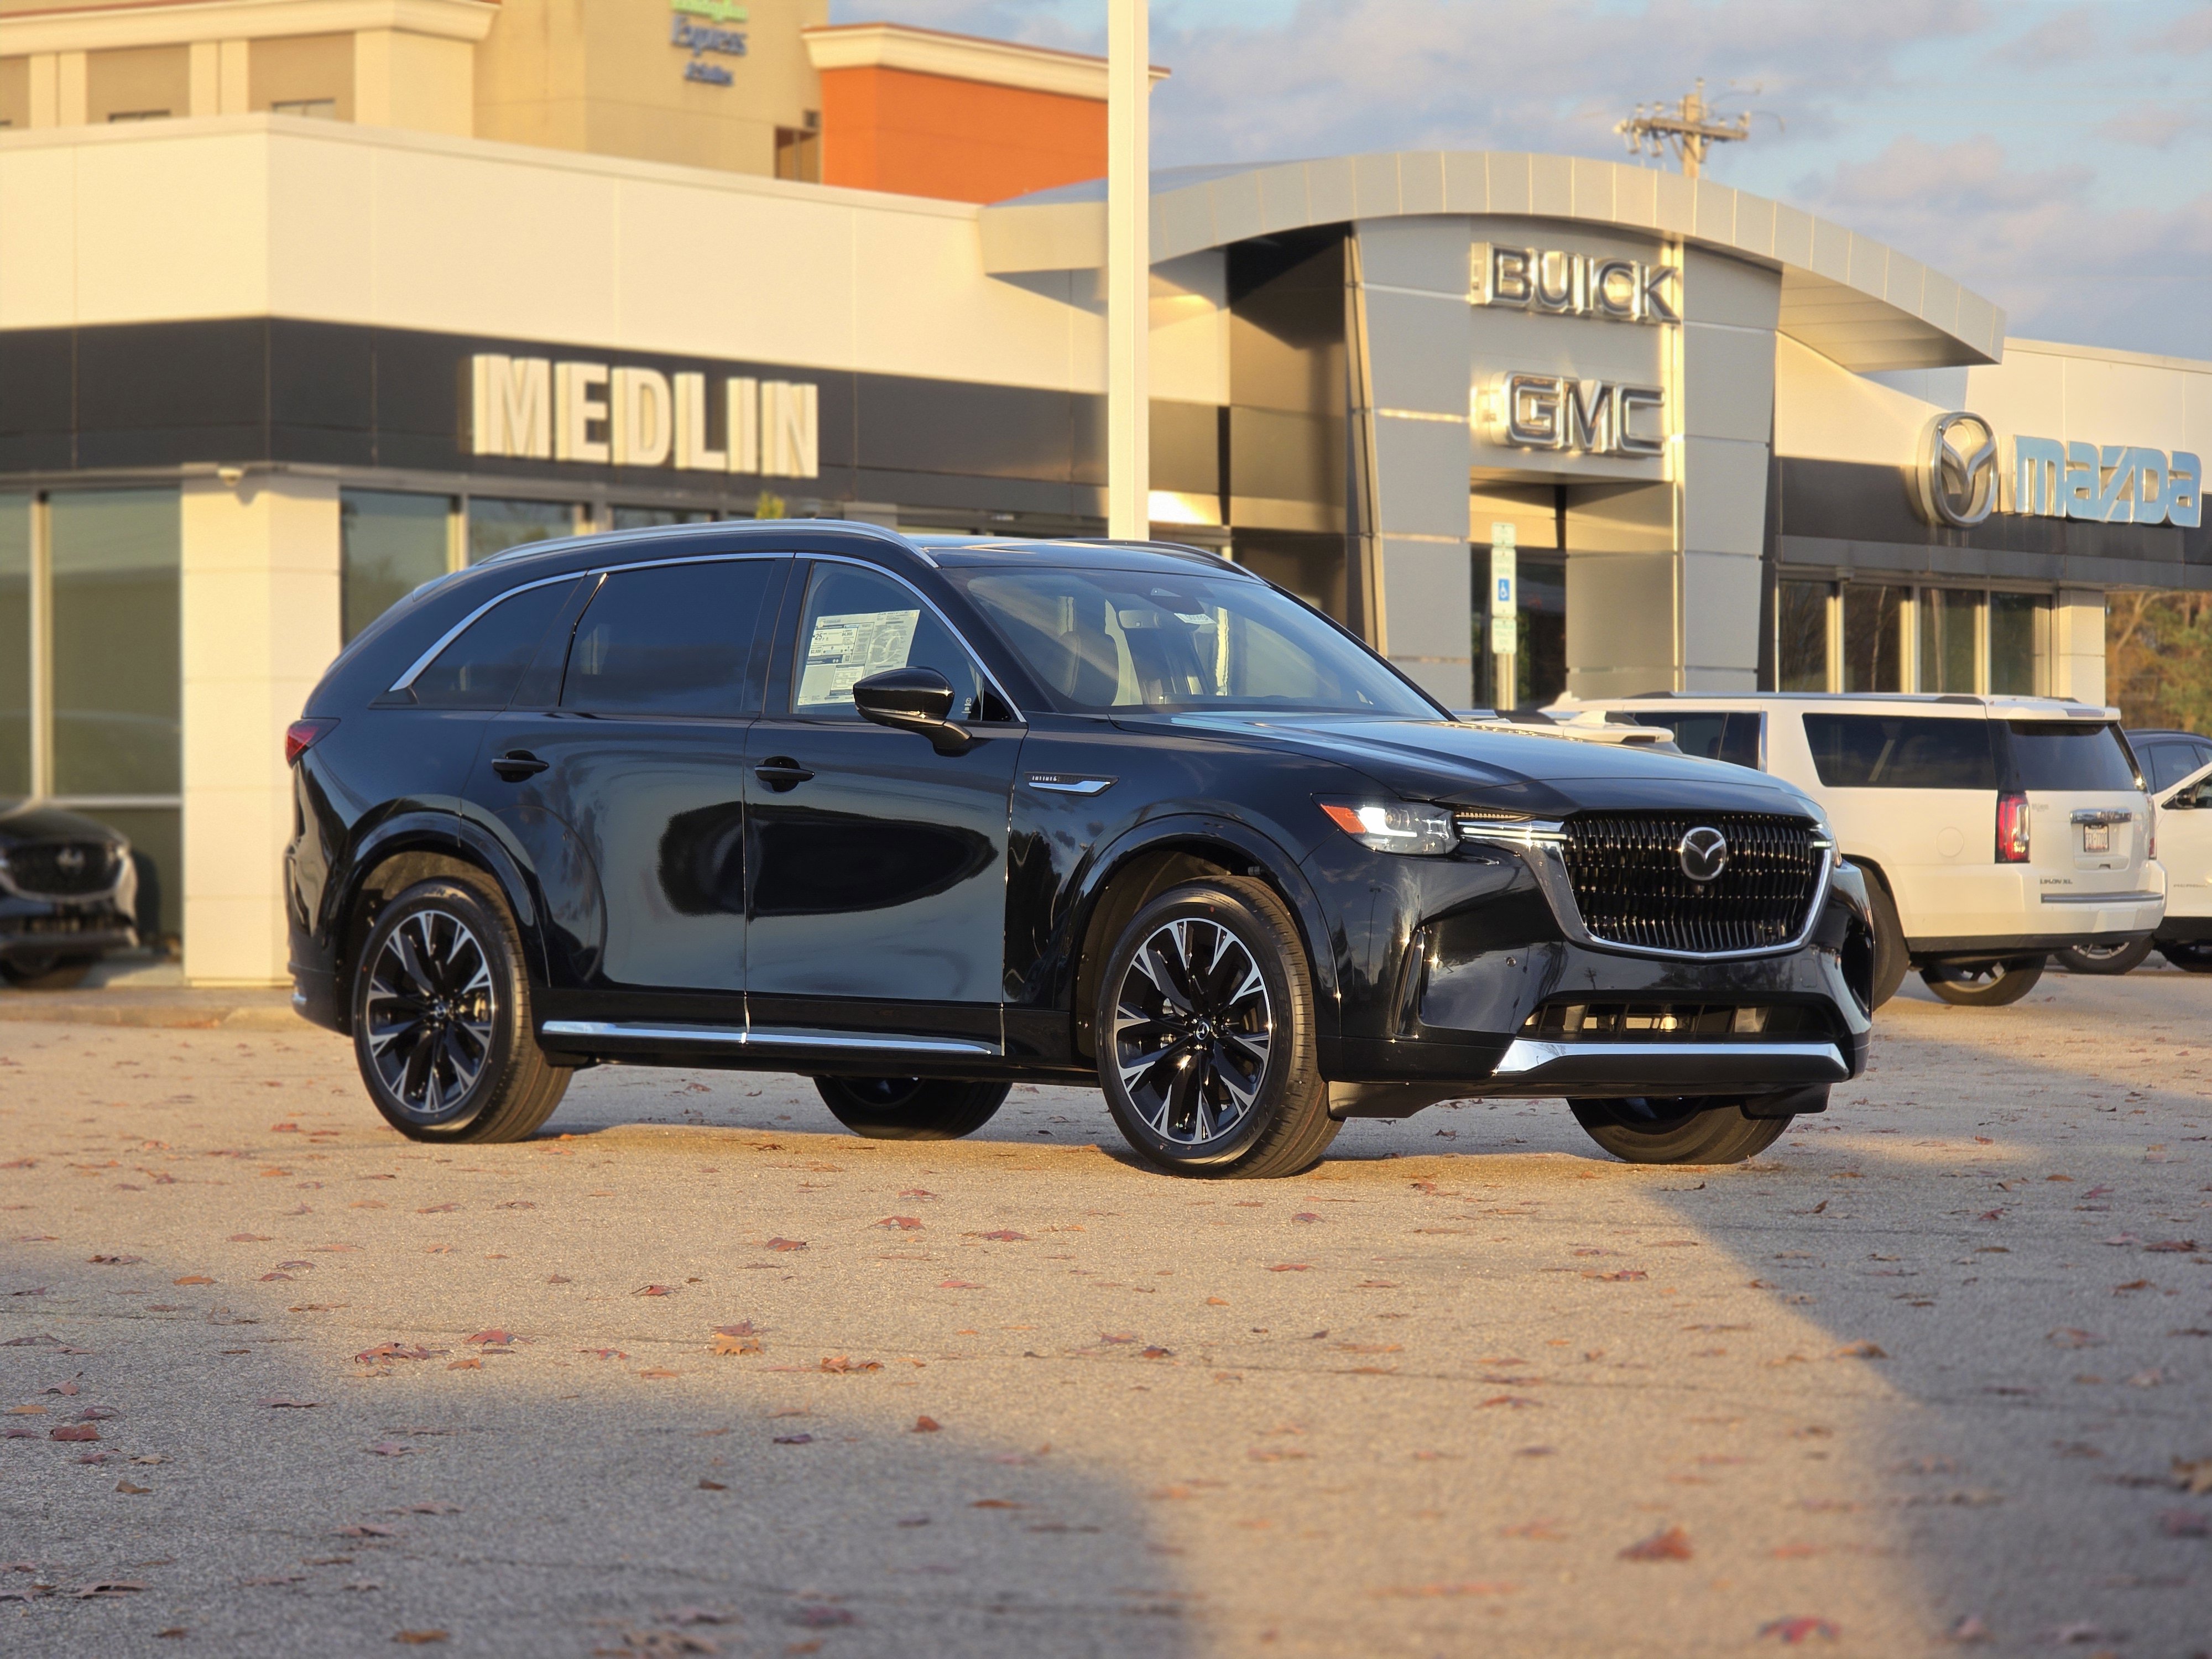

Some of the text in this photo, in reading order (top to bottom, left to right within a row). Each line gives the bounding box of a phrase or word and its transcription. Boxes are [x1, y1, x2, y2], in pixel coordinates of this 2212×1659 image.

[1486, 242, 1682, 325] BUICK
[473, 354, 818, 478] MEDLIN
[1505, 371, 1665, 457] GMC
